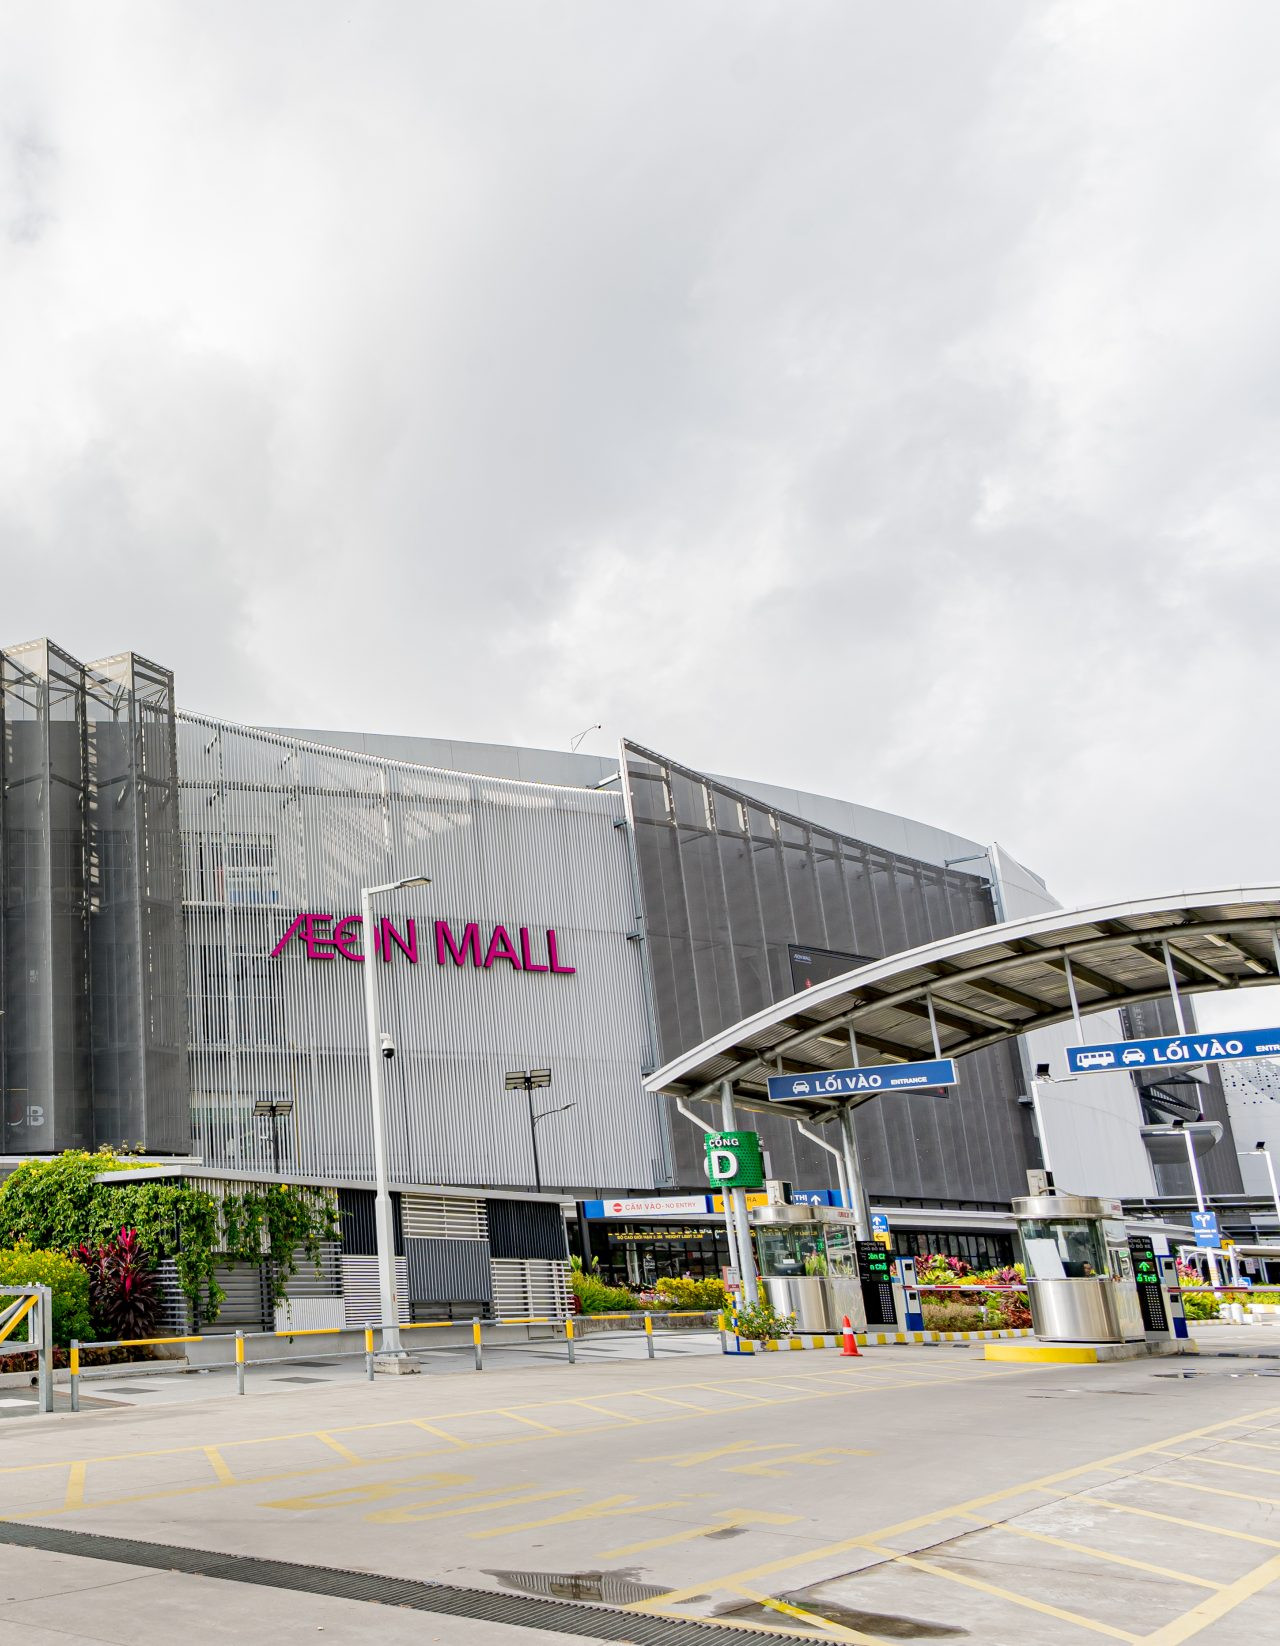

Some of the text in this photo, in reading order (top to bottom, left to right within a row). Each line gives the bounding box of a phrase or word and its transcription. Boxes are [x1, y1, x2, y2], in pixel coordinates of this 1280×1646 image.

[435, 920, 576, 974] MALL
[1152, 1041, 1190, 1062] LỐI
[1193, 1038, 1243, 1058] VÀO
[815, 1073, 928, 1092] LỐI VÀO ENTRANCE
[710, 1150, 738, 1179] D
[675, 1201, 696, 1209] ENTRY
[635, 1439, 877, 1477] XE
